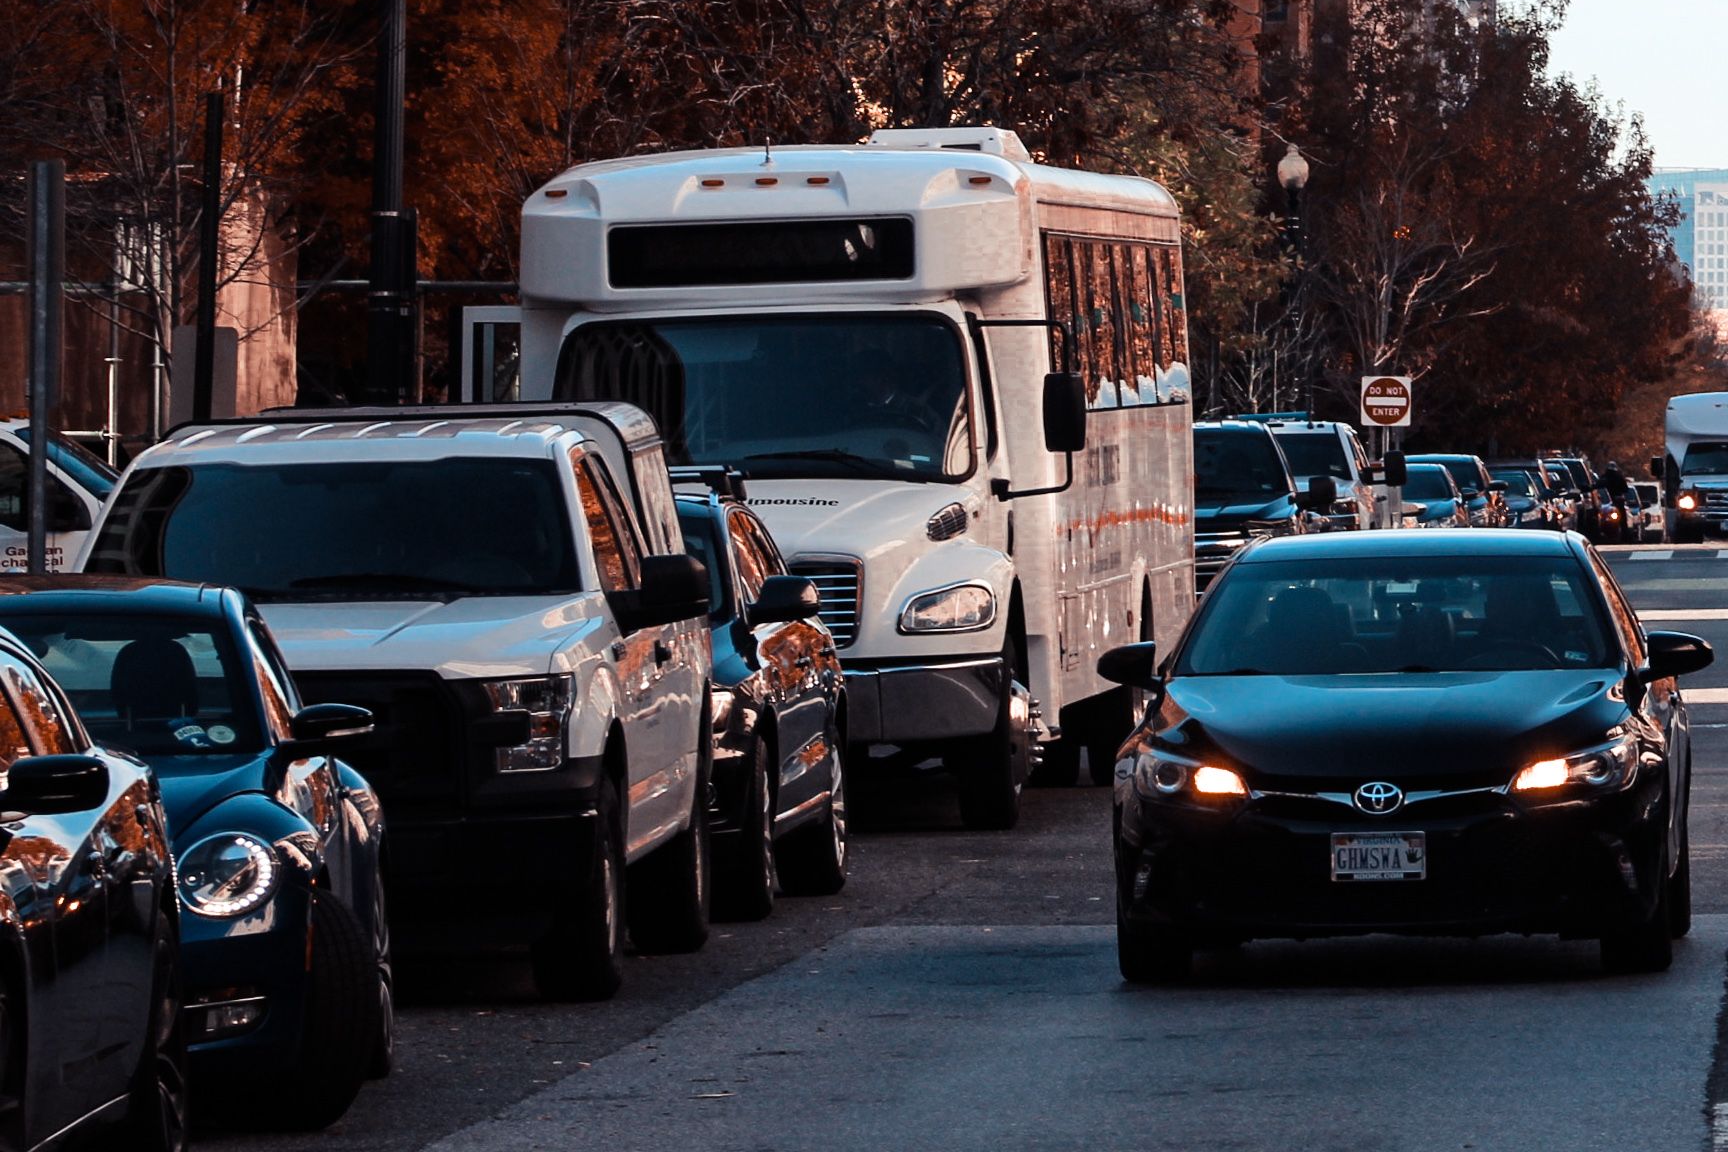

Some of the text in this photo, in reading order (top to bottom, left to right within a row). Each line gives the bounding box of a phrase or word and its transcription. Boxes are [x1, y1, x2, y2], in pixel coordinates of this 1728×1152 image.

[1369, 386, 1403, 395] DO NOT
[1372, 407, 1400, 416] ENTER
[748, 497, 839, 506] imousine
[5, 546, 63, 557] Gaan
[1337, 847, 1402, 869] GHMSWA
